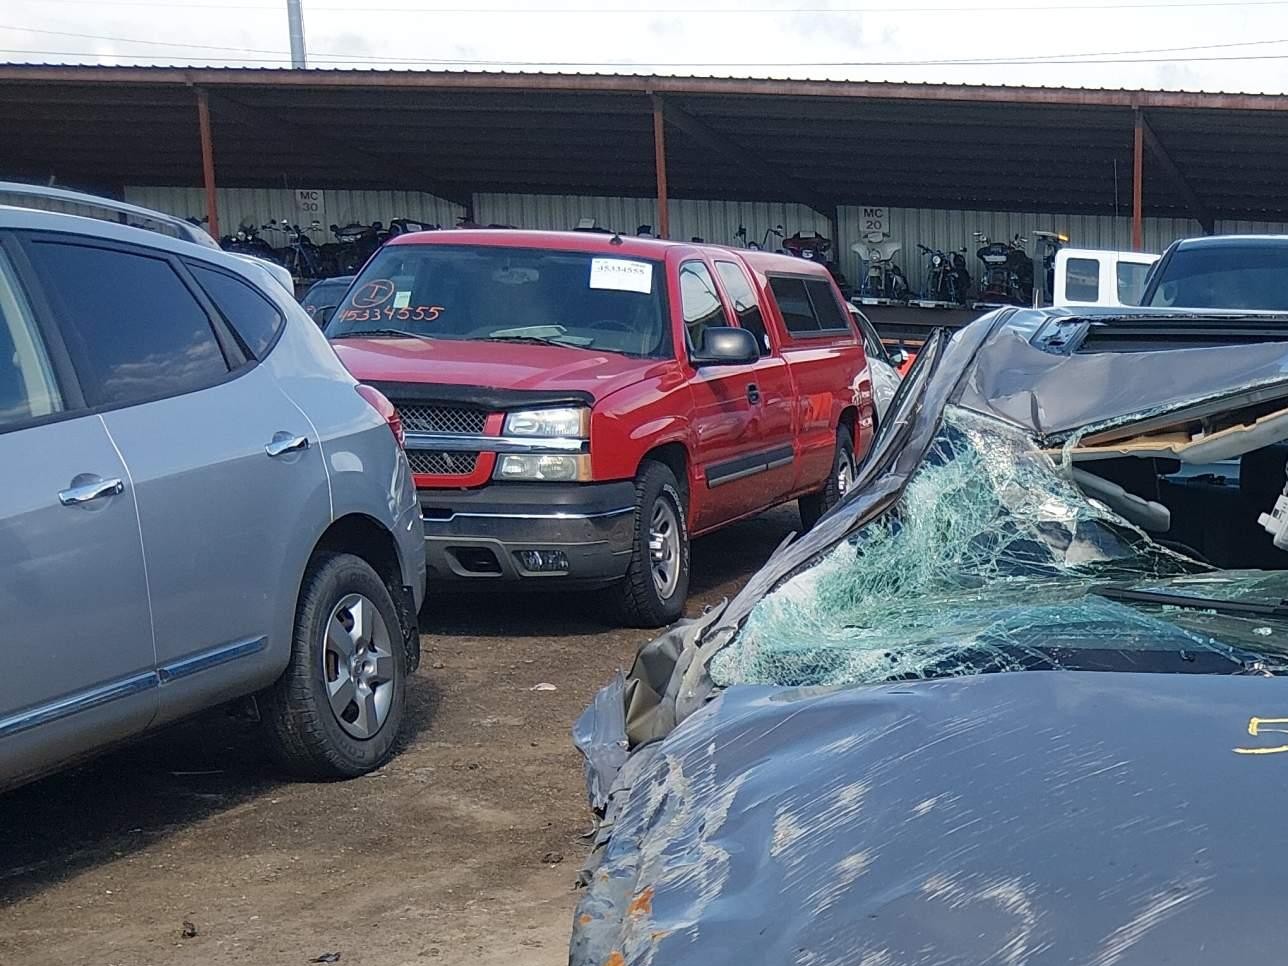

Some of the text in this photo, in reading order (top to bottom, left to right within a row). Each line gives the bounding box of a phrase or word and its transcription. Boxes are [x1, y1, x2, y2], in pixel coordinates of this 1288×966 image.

[300, 191, 318, 201] MC
[302, 202, 318, 212] 30
[863, 208, 884, 218] MC
[866, 220, 882, 230] 20
